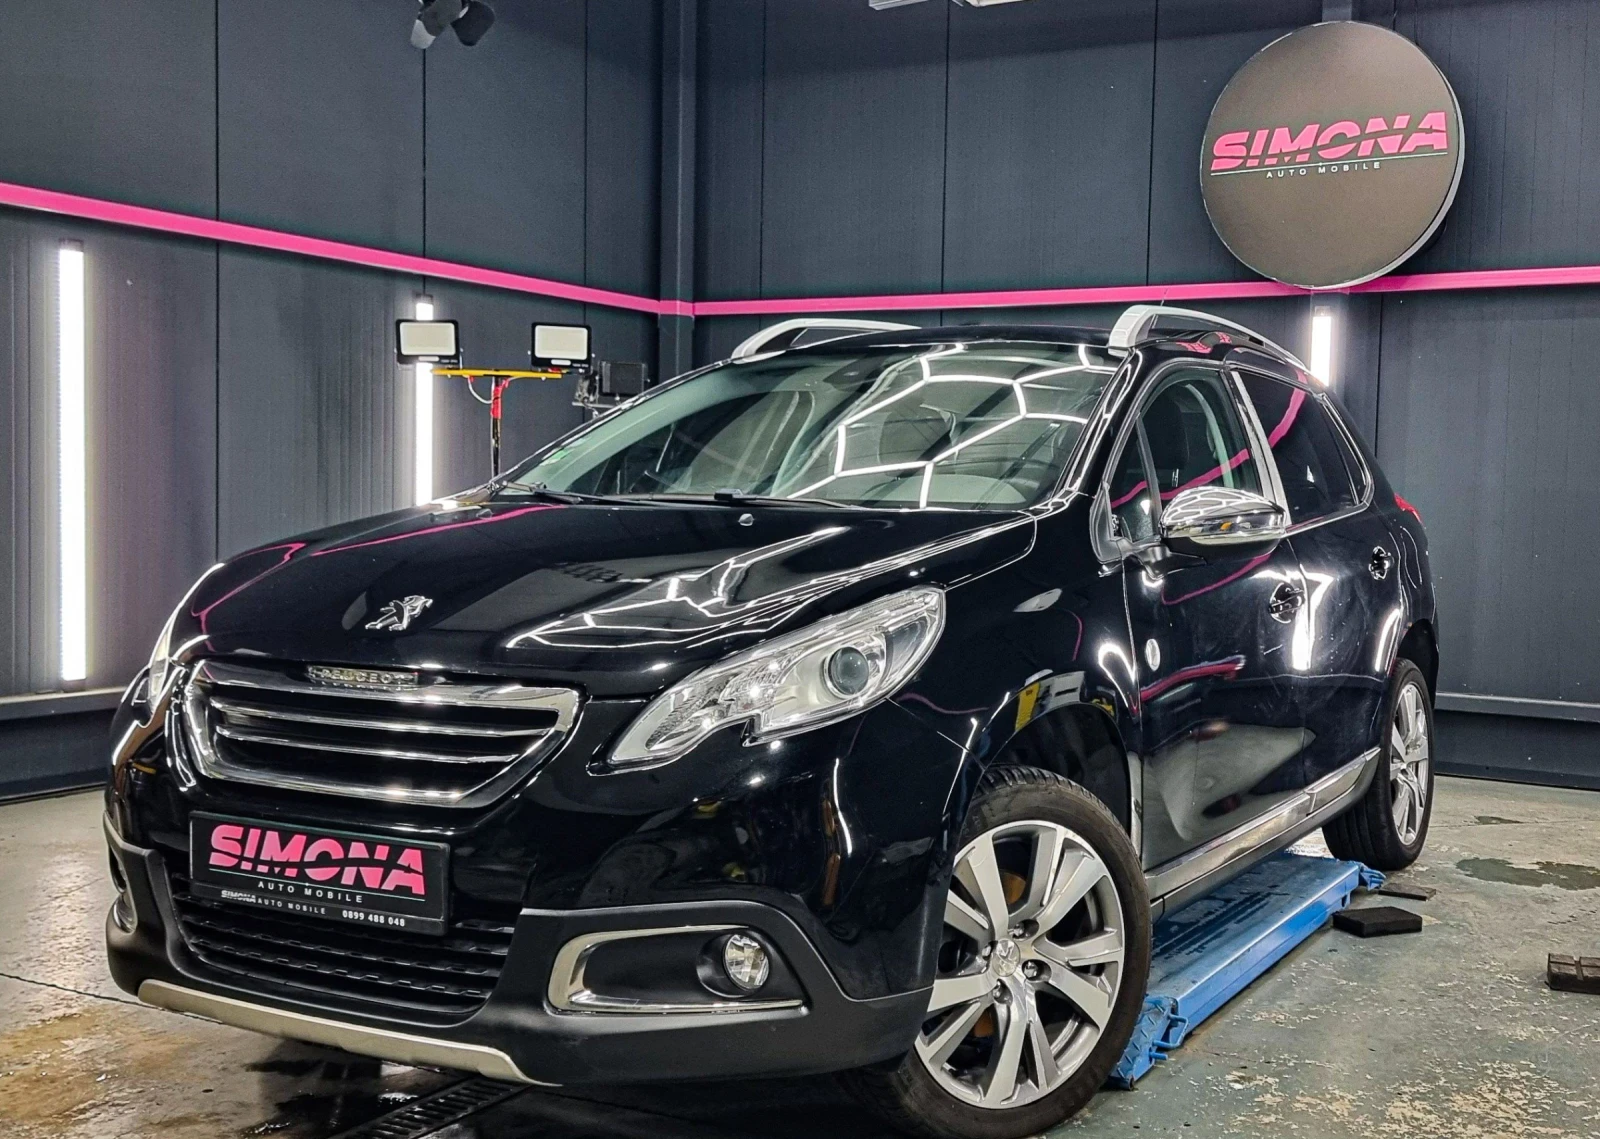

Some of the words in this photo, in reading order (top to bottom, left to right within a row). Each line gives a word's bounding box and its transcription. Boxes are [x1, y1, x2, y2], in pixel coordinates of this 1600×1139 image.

[1210, 111, 1448, 171] SIMONA
[1266, 168, 1307, 179] AUTO
[1318, 161, 1381, 174] MOBILE
[208, 824, 426, 896] SIMONA
[257, 881, 295, 893] AUTO
[304, 888, 363, 903] MOBILE
[257, 898, 283, 908] AUTO
[287, 903, 326, 915] MOBILE
[342, 910, 365, 920] 0899
[367, 913, 385, 924] 488
[388, 916, 406, 927] 048
